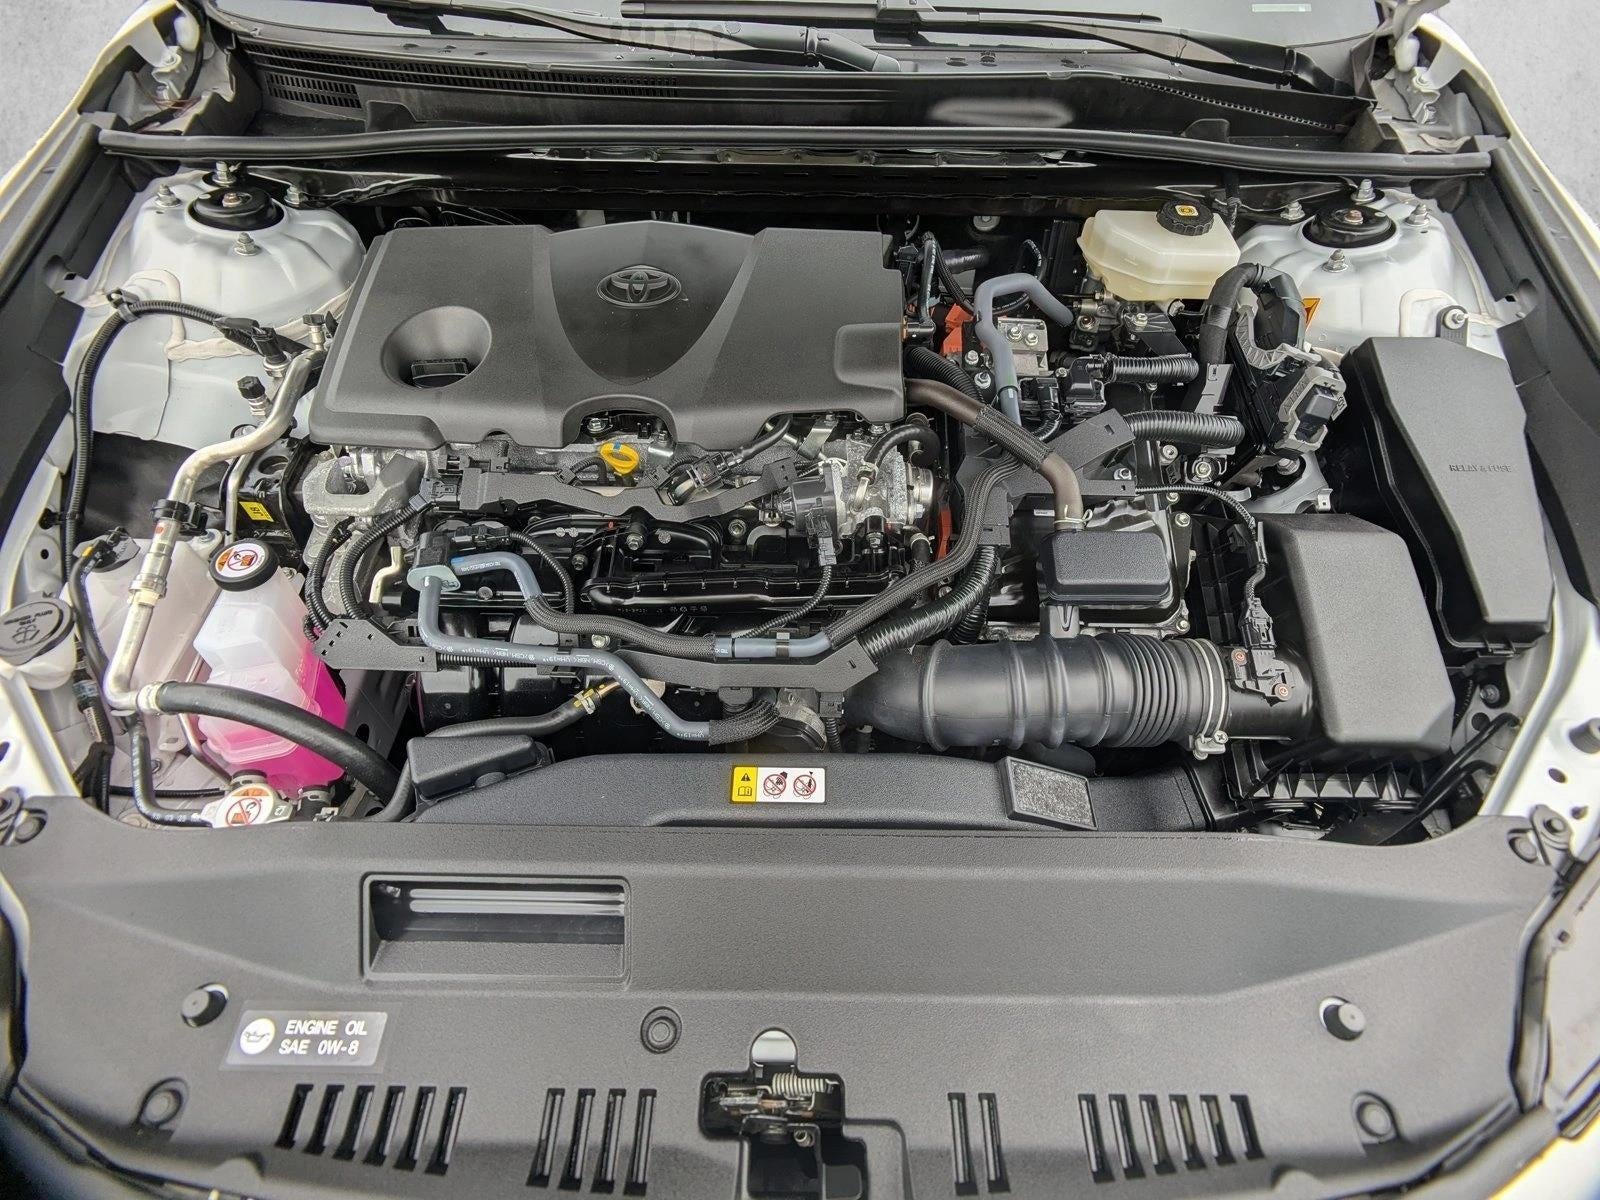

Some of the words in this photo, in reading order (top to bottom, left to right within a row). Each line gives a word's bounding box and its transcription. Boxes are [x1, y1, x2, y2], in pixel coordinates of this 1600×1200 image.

[285, 1020, 338, 1035] ENGINE
[344, 1020, 368, 1036] OIL
[278, 1039, 311, 1055] SAE
[317, 1039, 360, 1055] 0W-8
